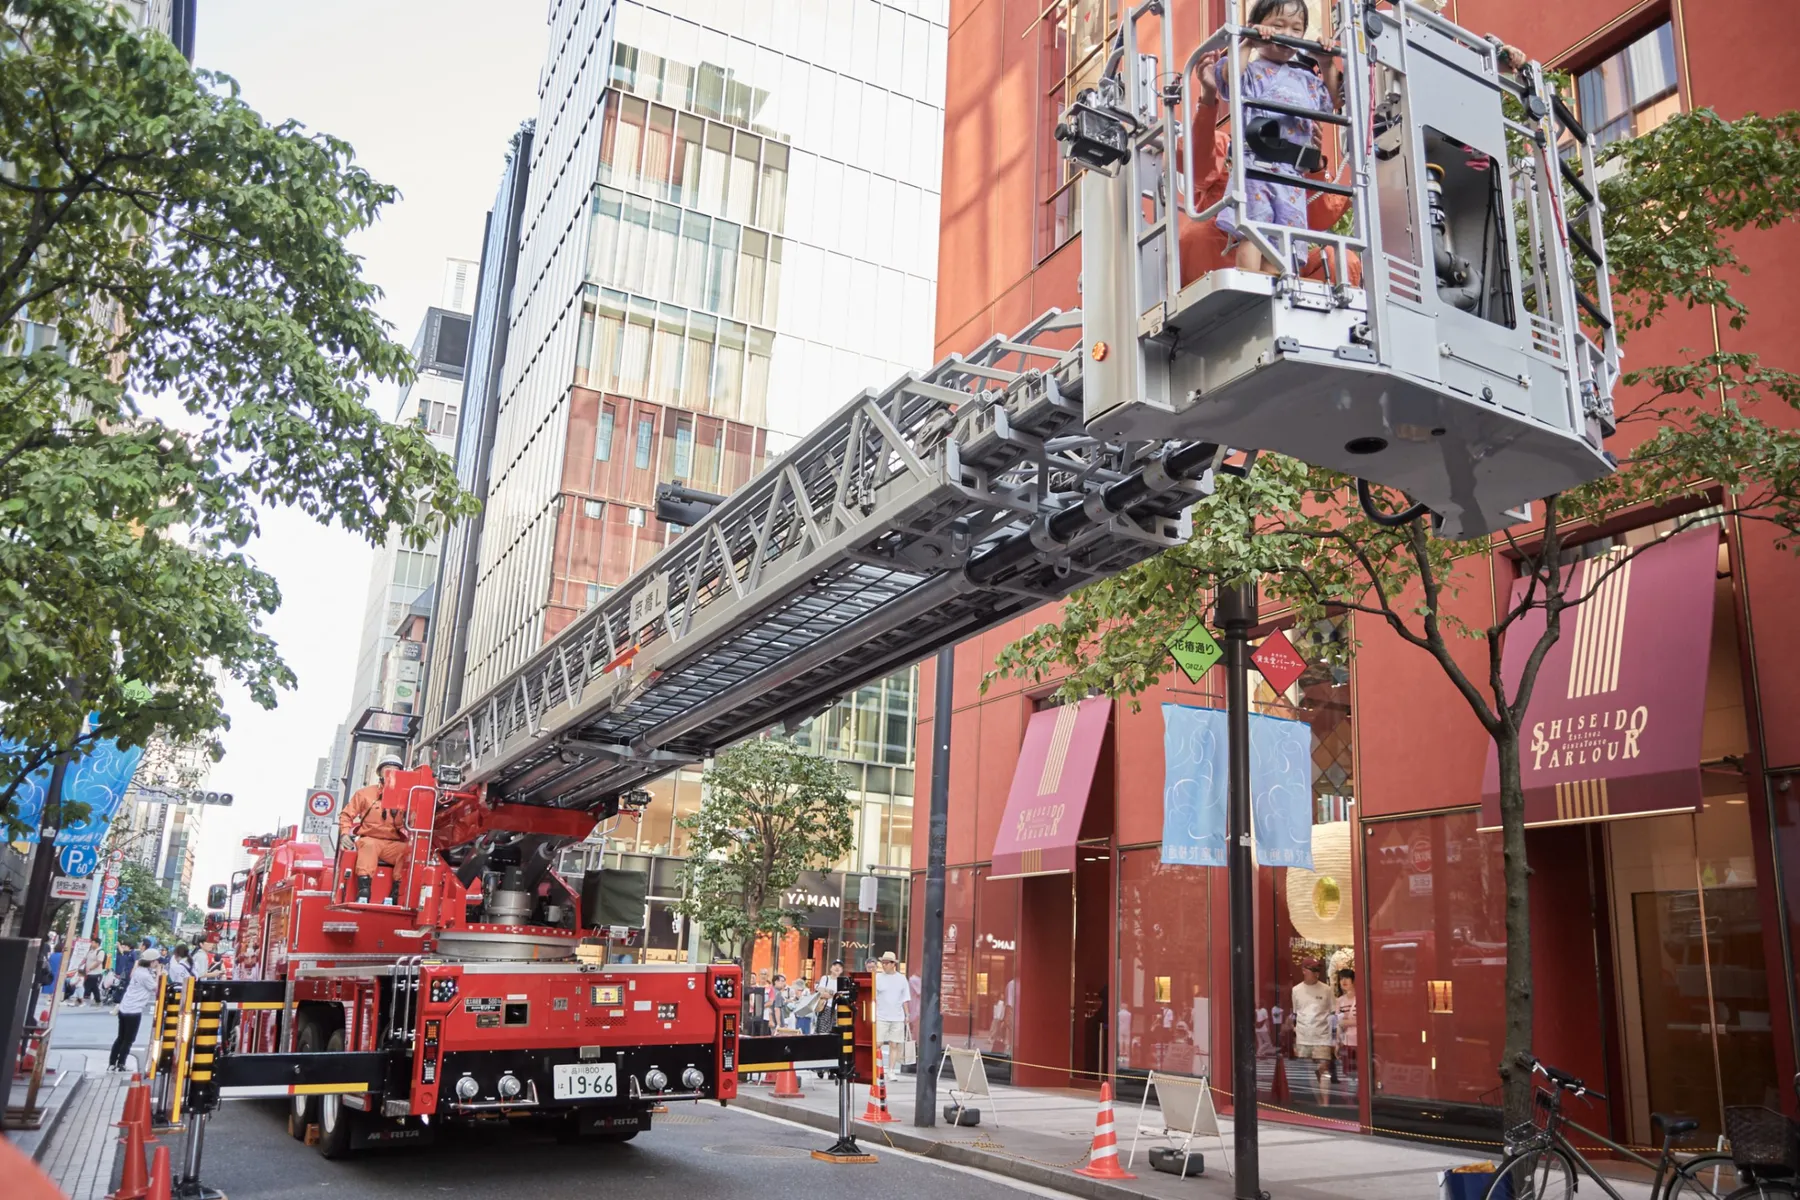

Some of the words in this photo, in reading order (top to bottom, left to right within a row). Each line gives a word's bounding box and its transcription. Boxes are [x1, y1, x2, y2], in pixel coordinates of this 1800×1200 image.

[1174, 639, 1215, 656] 花椿通り
[1185, 662, 1205, 672] GINZA
[1531, 705, 1648, 751] SHISEIDO
[1533, 728, 1641, 771] PARLOUR
[66, 850, 84, 873] P
[569, 1075, 614, 1095] 19-66
